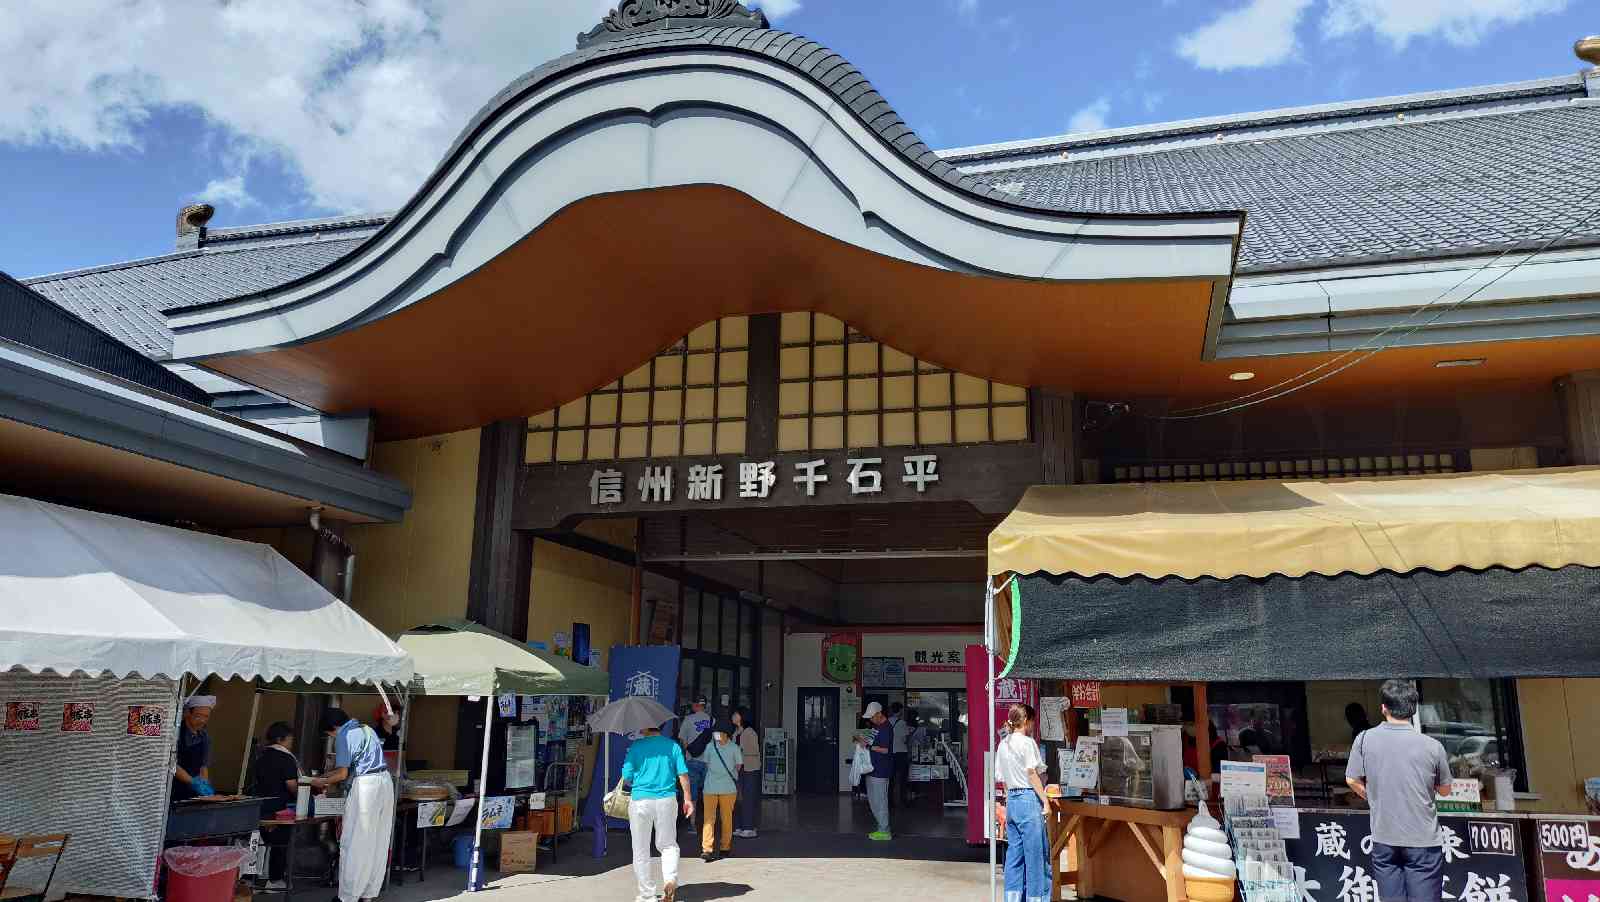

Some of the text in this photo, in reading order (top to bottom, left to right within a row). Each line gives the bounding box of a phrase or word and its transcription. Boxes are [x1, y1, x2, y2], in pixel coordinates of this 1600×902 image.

[589, 454, 940, 505] 信州新野千石平
[1470, 825, 1512, 852] 700円
[1541, 823, 1587, 849] 500円
